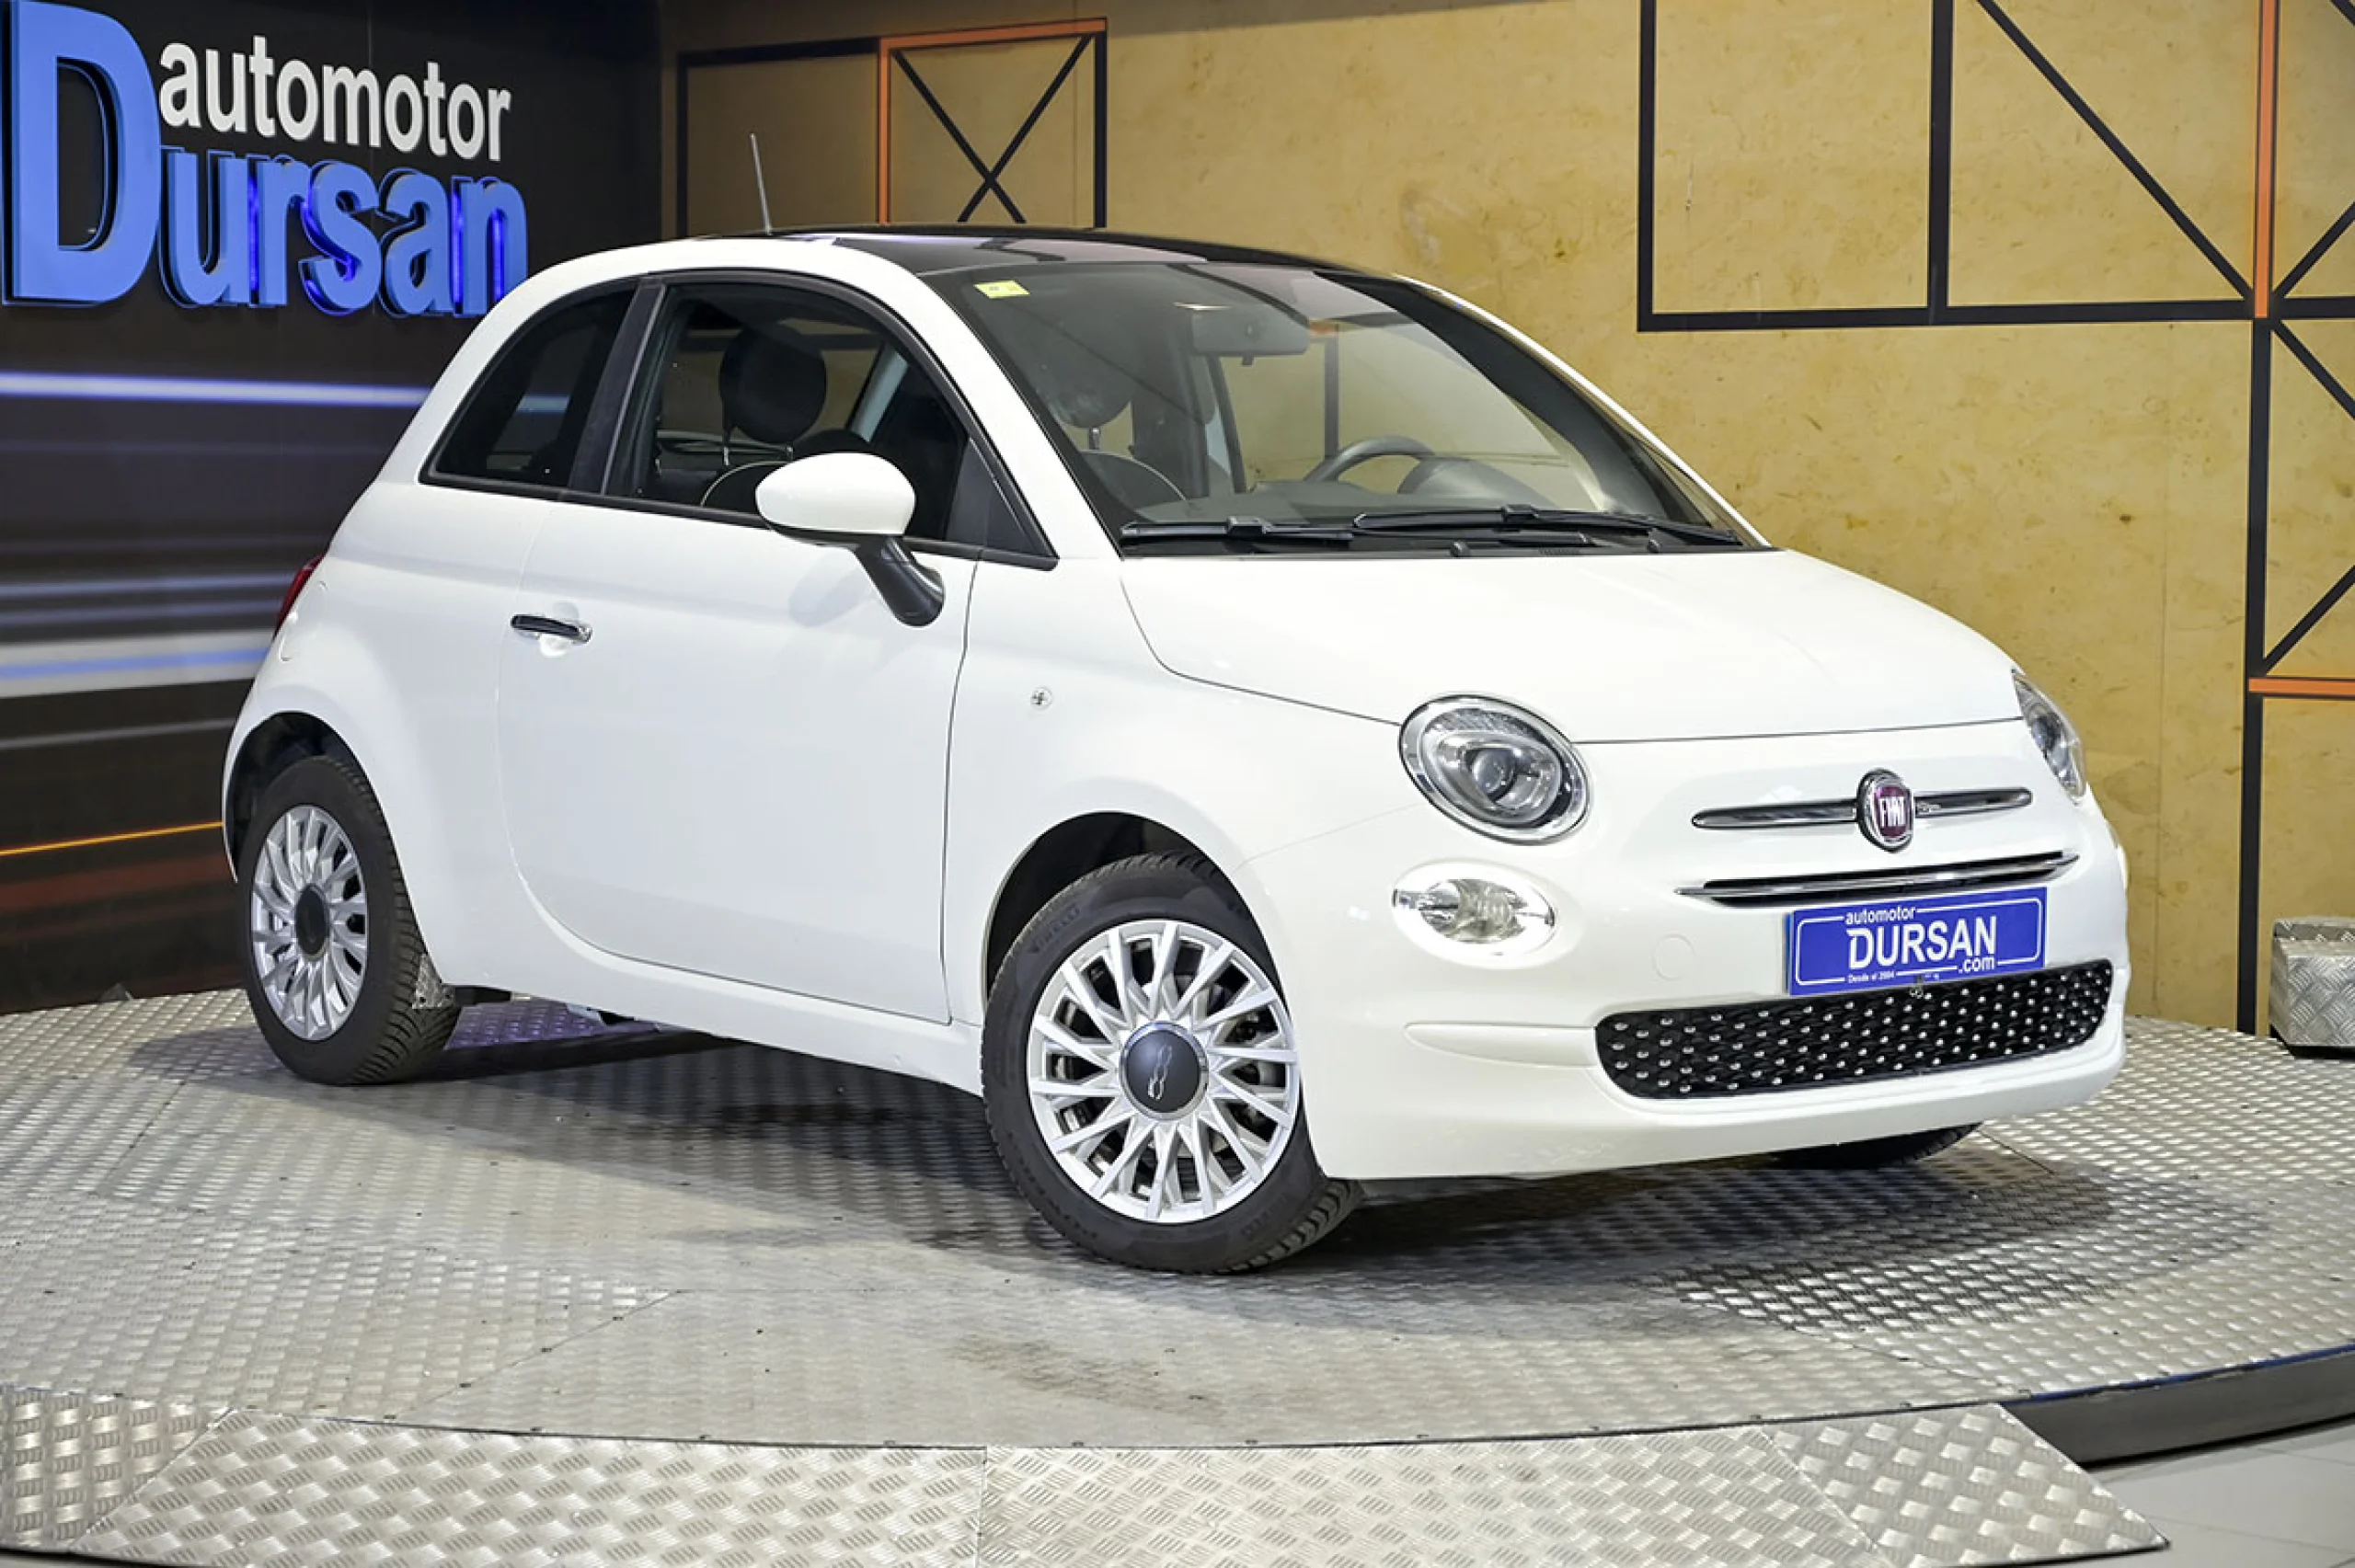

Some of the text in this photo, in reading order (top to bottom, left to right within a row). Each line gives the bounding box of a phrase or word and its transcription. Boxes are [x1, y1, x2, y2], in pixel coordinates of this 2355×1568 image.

[159, 35, 511, 161] automotor
[5, 0, 527, 316] Dursan
[1879, 796, 1905, 827] FIAT
[1845, 906, 1916, 924] automotor
[1846, 916, 1996, 969] DURSAN
[1958, 956, 1995, 973] .com
